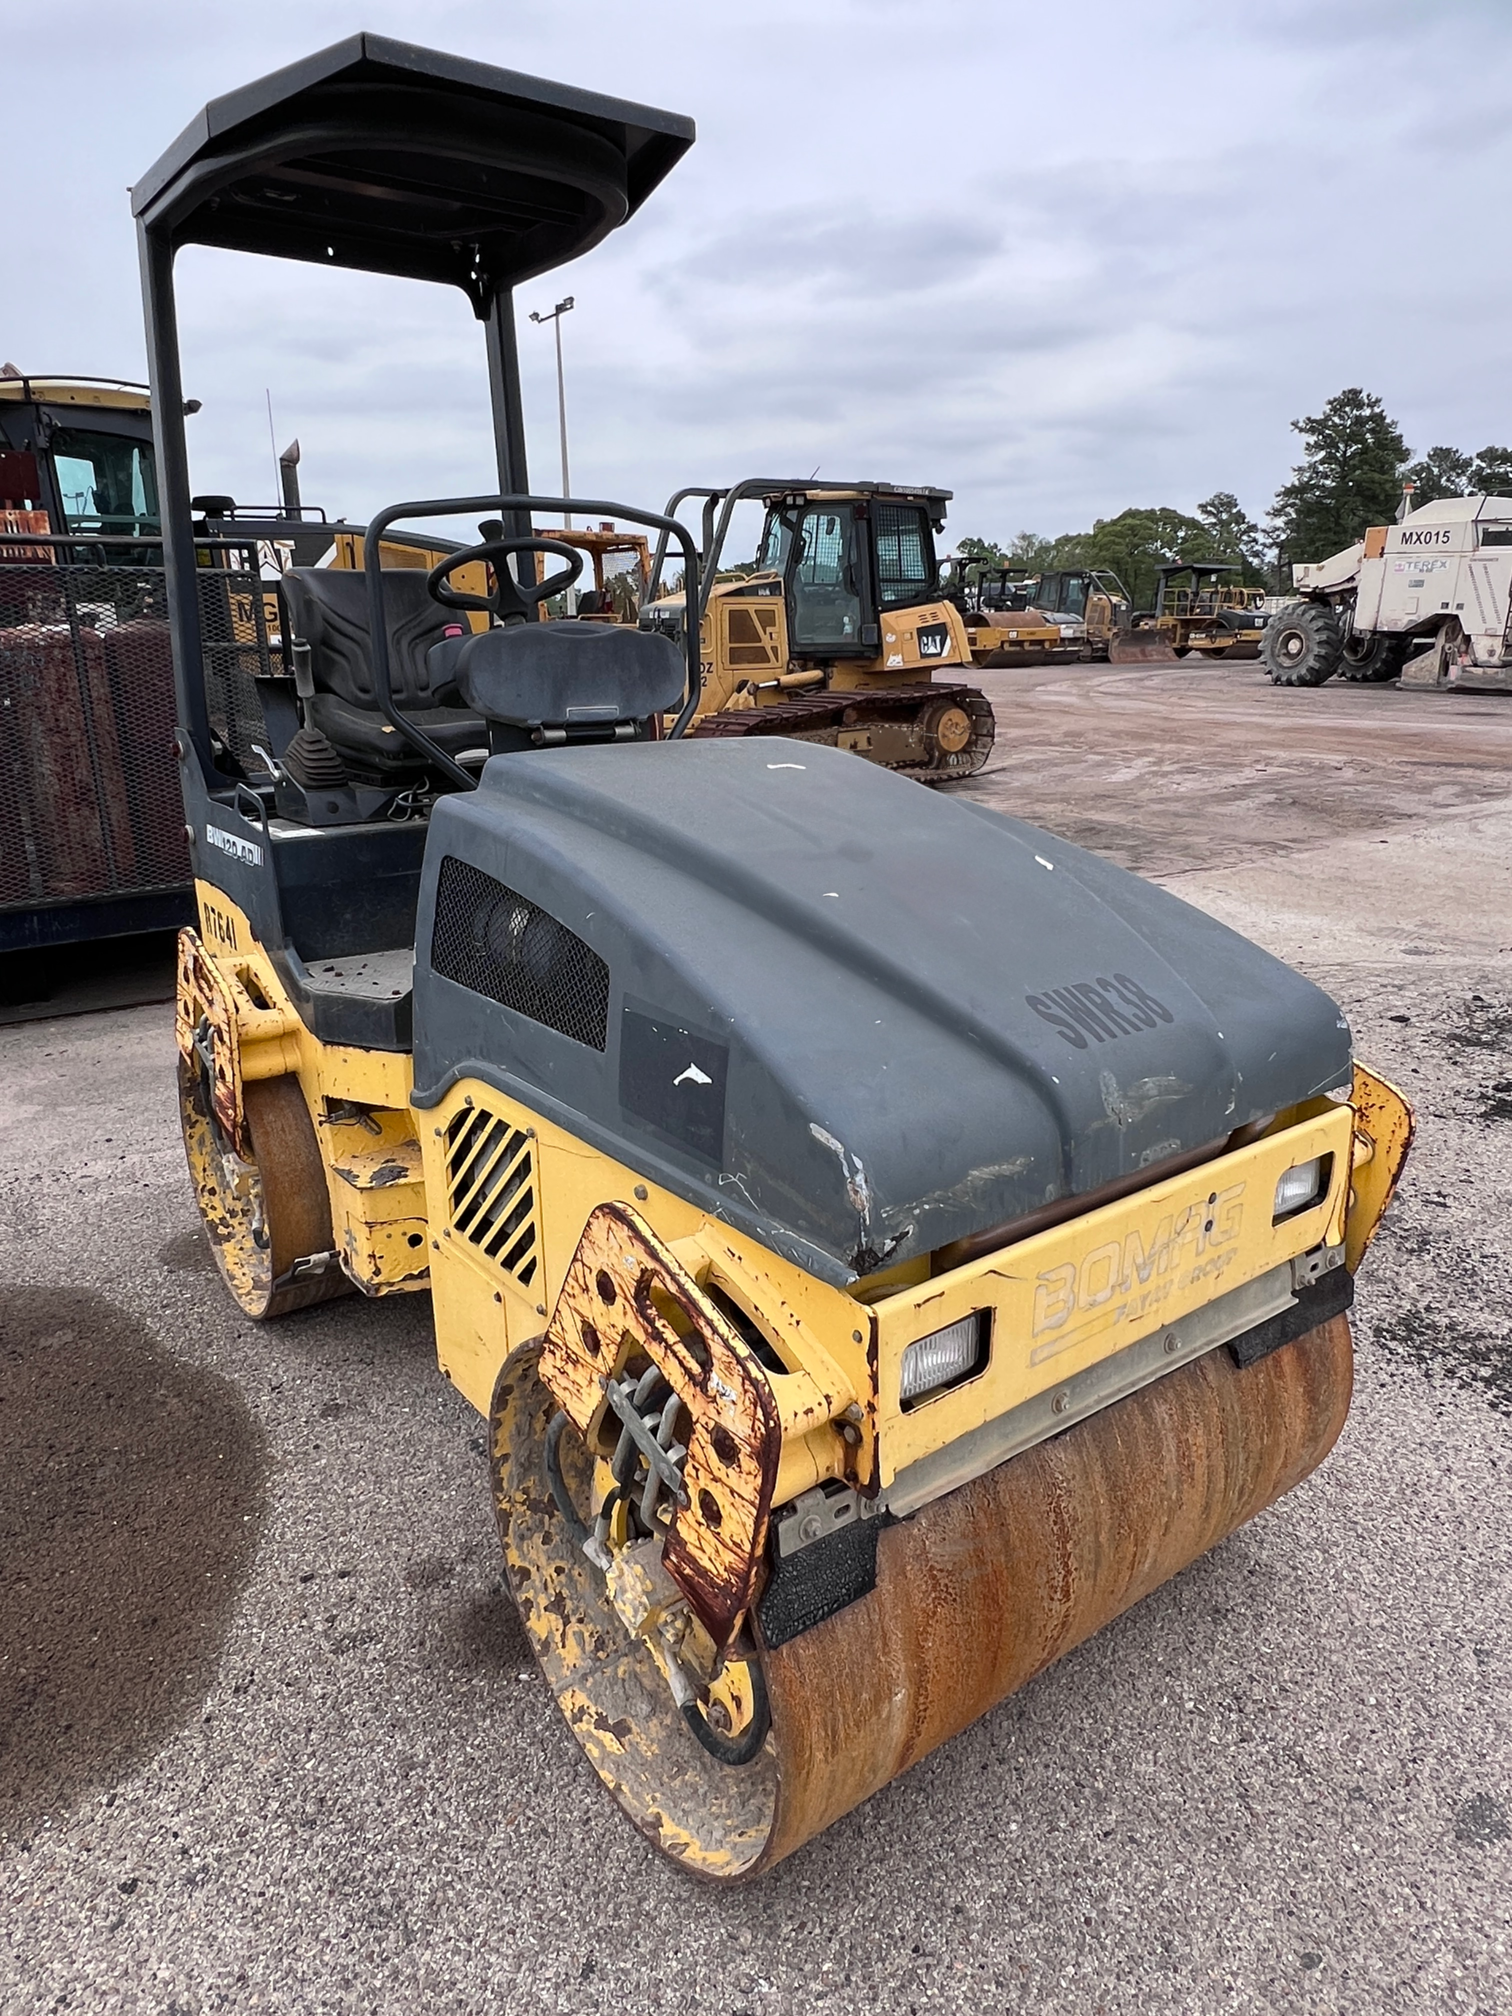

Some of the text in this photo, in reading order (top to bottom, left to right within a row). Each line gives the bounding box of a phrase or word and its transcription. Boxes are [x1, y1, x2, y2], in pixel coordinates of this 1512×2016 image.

[1401, 530, 1451, 545] MX015
[1406, 560, 1448, 570] TEREX
[921, 635, 941, 654] CAT
[1025, 973, 1175, 1049] SWR38
[1031, 1181, 1247, 1338] BOMAG
[1177, 1247, 1239, 1290] GROUP
